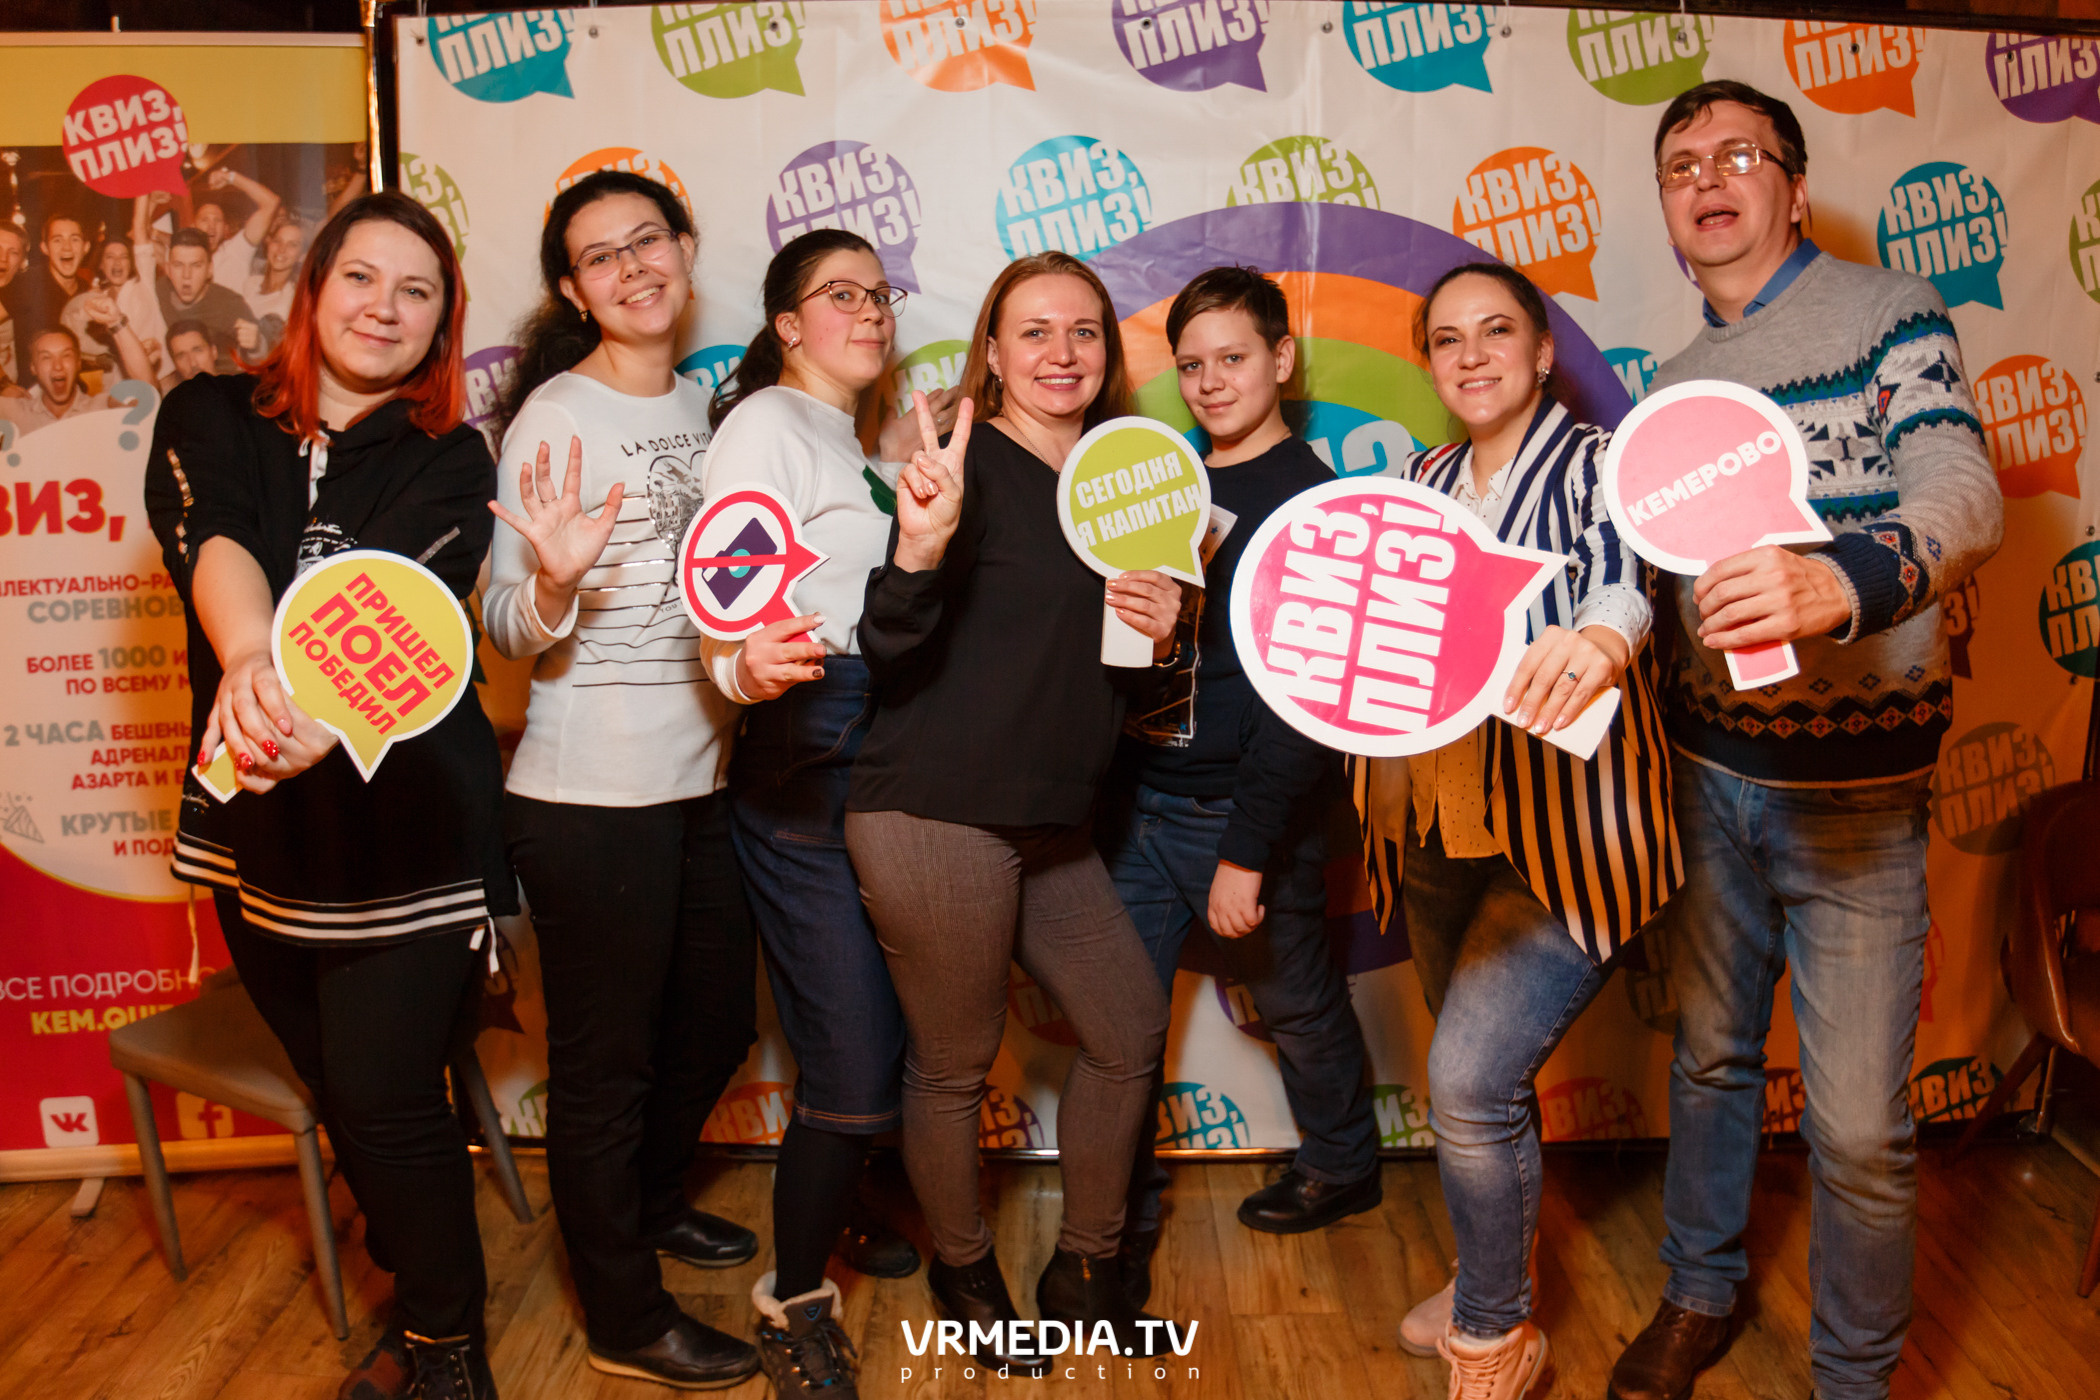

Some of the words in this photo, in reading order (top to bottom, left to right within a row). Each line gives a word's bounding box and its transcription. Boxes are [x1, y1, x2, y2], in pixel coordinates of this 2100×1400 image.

[438, 9, 575, 83] ПЛИЗ!
[1123, 0, 1270, 70] ПЛИЗ!
[1353, 3, 1497, 70] ПЛИЗ!
[1793, 25, 1925, 91] ПЛИЗ!
[64, 89, 183, 146] КВИЗ,
[69, 121, 188, 183] ПЛИЗ!
[772, 146, 907, 223] КВИЗ,
[1002, 142, 1138, 218] КВИЗ,
[1232, 139, 1367, 205] КВИЗ,
[1007, 185, 1152, 259] ПЛИЗ!
[1459, 153, 1589, 226] КВИЗ,
[1884, 167, 1999, 236] КВИЗ,
[1886, 211, 2008, 278] ПЛИЗ!
[621, 441, 647, 457] LA
[648, 434, 692, 452] DOLCE
[1626, 430, 1782, 527] КЕМЕРОВО
[0, 478, 127, 542] ИЗ,
[1075, 450, 1183, 510] СЕГОДНЯ
[1077, 519, 1096, 549] Я
[1099, 483, 1201, 543] КАПИТАН
[345, 571, 455, 690] ПРИШЕЛ
[1266, 502, 1380, 706] КВИЗ,
[1347, 501, 1459, 734] ПЛИЗ!
[27, 654, 94, 674] БОЛЕЕ
[98, 645, 166, 669] 1000
[66, 678, 97, 695] ПО
[103, 674, 171, 693] ВСЕМУ
[288, 621, 398, 735] ПОБЕДИЛ
[310, 592, 432, 718] ПОЕЛ
[3, 725, 20, 746] 2
[26, 720, 104, 745] ЧАСА
[91, 744, 190, 766] АДРЕНАЛ
[1939, 726, 2047, 795] КВИЗ,
[72, 770, 149, 790] АЗАРТА
[154, 769, 168, 786] И
[61, 809, 172, 836] КРУТЫЕ
[113, 841, 126, 856] И
